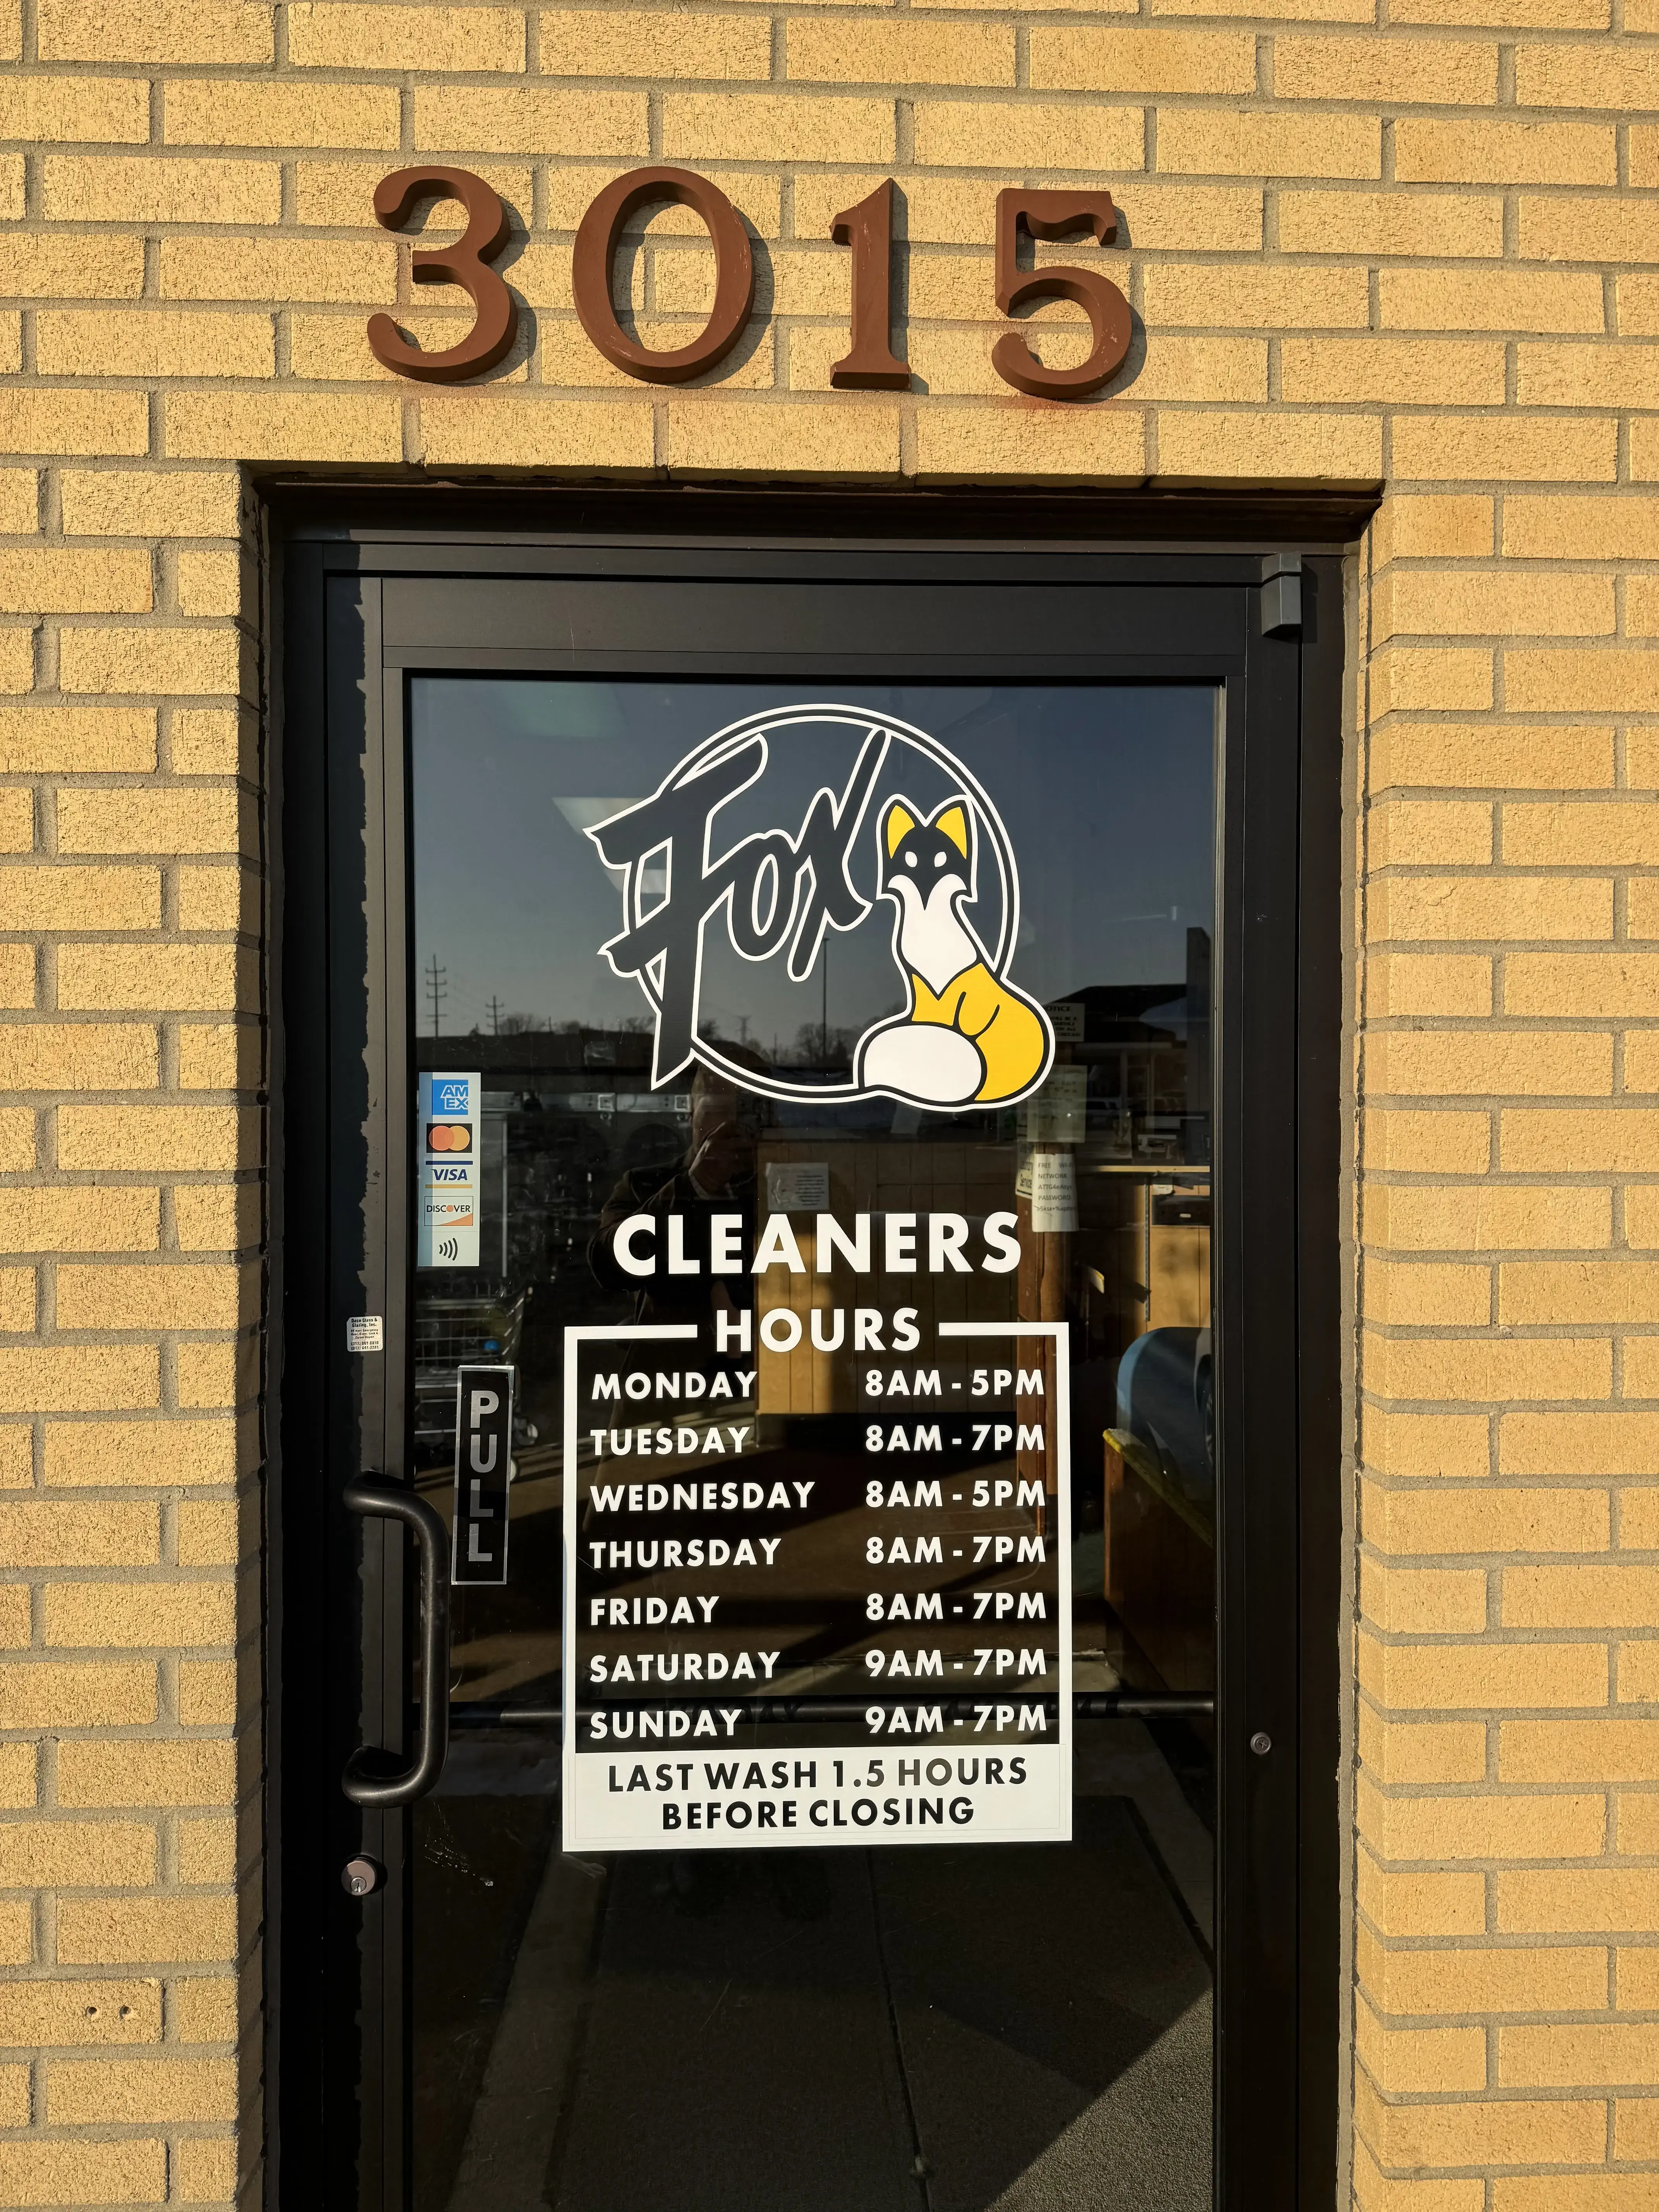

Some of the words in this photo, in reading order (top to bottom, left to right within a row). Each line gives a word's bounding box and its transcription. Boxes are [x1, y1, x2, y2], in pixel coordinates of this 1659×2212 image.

[367, 165, 1132, 399] 3015
[582, 727, 891, 1090] Fox
[431, 1169, 467, 1180] VISA
[613, 1212, 1021, 1276] CLEANERS
[717, 1308, 920, 1352] HOURS
[592, 1372, 757, 1400] MONDAY
[866, 1370, 942, 1396] 8AM
[972, 1369, 1044, 1396] 5PM
[591, 1427, 750, 1456] TUESDAY
[866, 1425, 942, 1451] 8AM
[972, 1425, 1045, 1450] 7PM
[468, 1391, 500, 1562] PULL
[590, 1482, 815, 1512] WEDNESDAY
[866, 1481, 943, 1507] 8AM
[973, 1480, 1045, 1507] 5PM
[590, 1539, 781, 1568] THURSDAY
[866, 1537, 943, 1564] 8AM
[973, 1536, 1046, 1563] 7PM
[591, 1596, 720, 1625] FRIDAY
[867, 1594, 943, 1620] 8AM
[974, 1593, 1046, 1619] 7PM
[590, 1652, 780, 1683] SATURDAY
[866, 1650, 943, 1677] 9AM
[974, 1649, 1046, 1675] 7PM
[590, 1709, 742, 1739] SUNDAY
[866, 1706, 944, 1733] 9AM
[974, 1705, 1046, 1731] 7PM
[610, 1764, 694, 1792] LAST
[704, 1761, 816, 1790] WASH
[833, 1760, 884, 1788] 1.5
[898, 1757, 1027, 1786] HOURS
[663, 1801, 797, 1830] BEFORE
[809, 1797, 974, 1827] CLOSING
